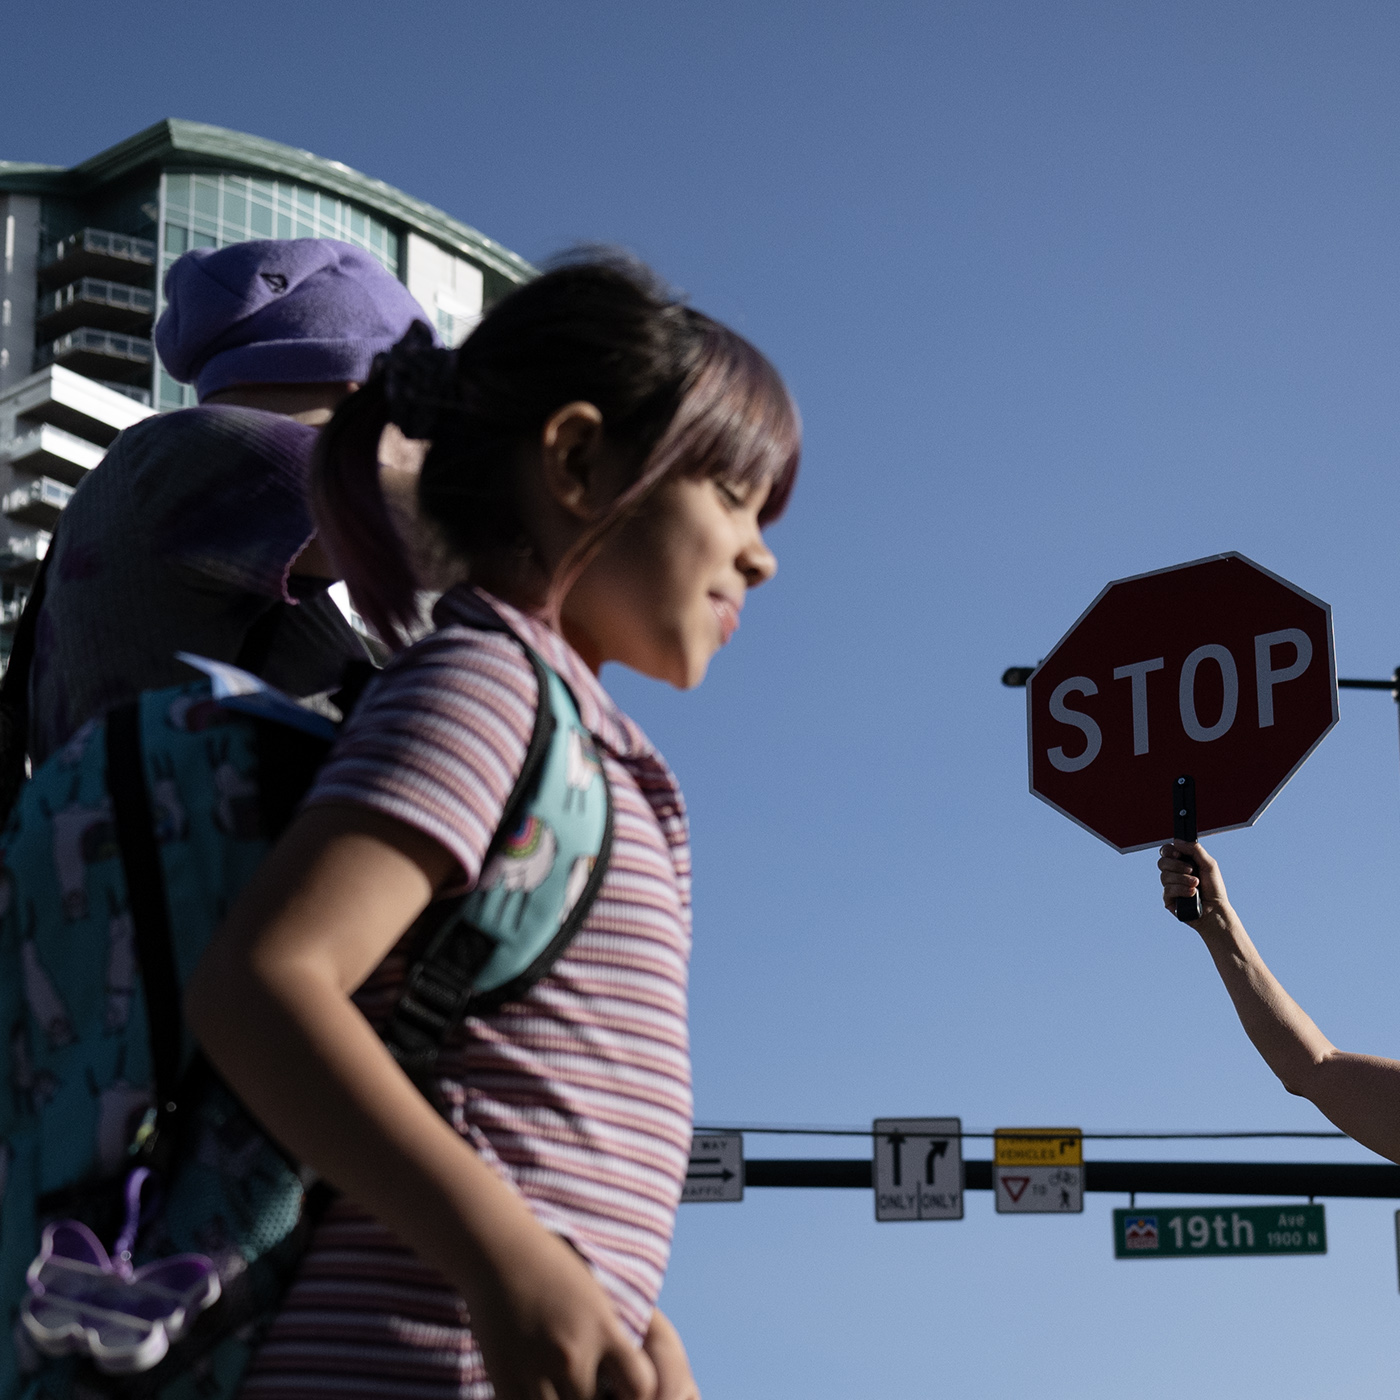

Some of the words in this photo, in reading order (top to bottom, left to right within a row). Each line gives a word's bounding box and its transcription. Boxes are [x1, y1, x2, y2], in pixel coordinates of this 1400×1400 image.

[1046, 627, 1314, 773] STOP
[878, 1194, 917, 1210] ONLY
[921, 1194, 960, 1210] ONLY
[1278, 1213, 1305, 1228] Ave
[1168, 1212, 1256, 1249] 19th
[1267, 1231, 1302, 1247] 1900
[1307, 1231, 1319, 1246] N
